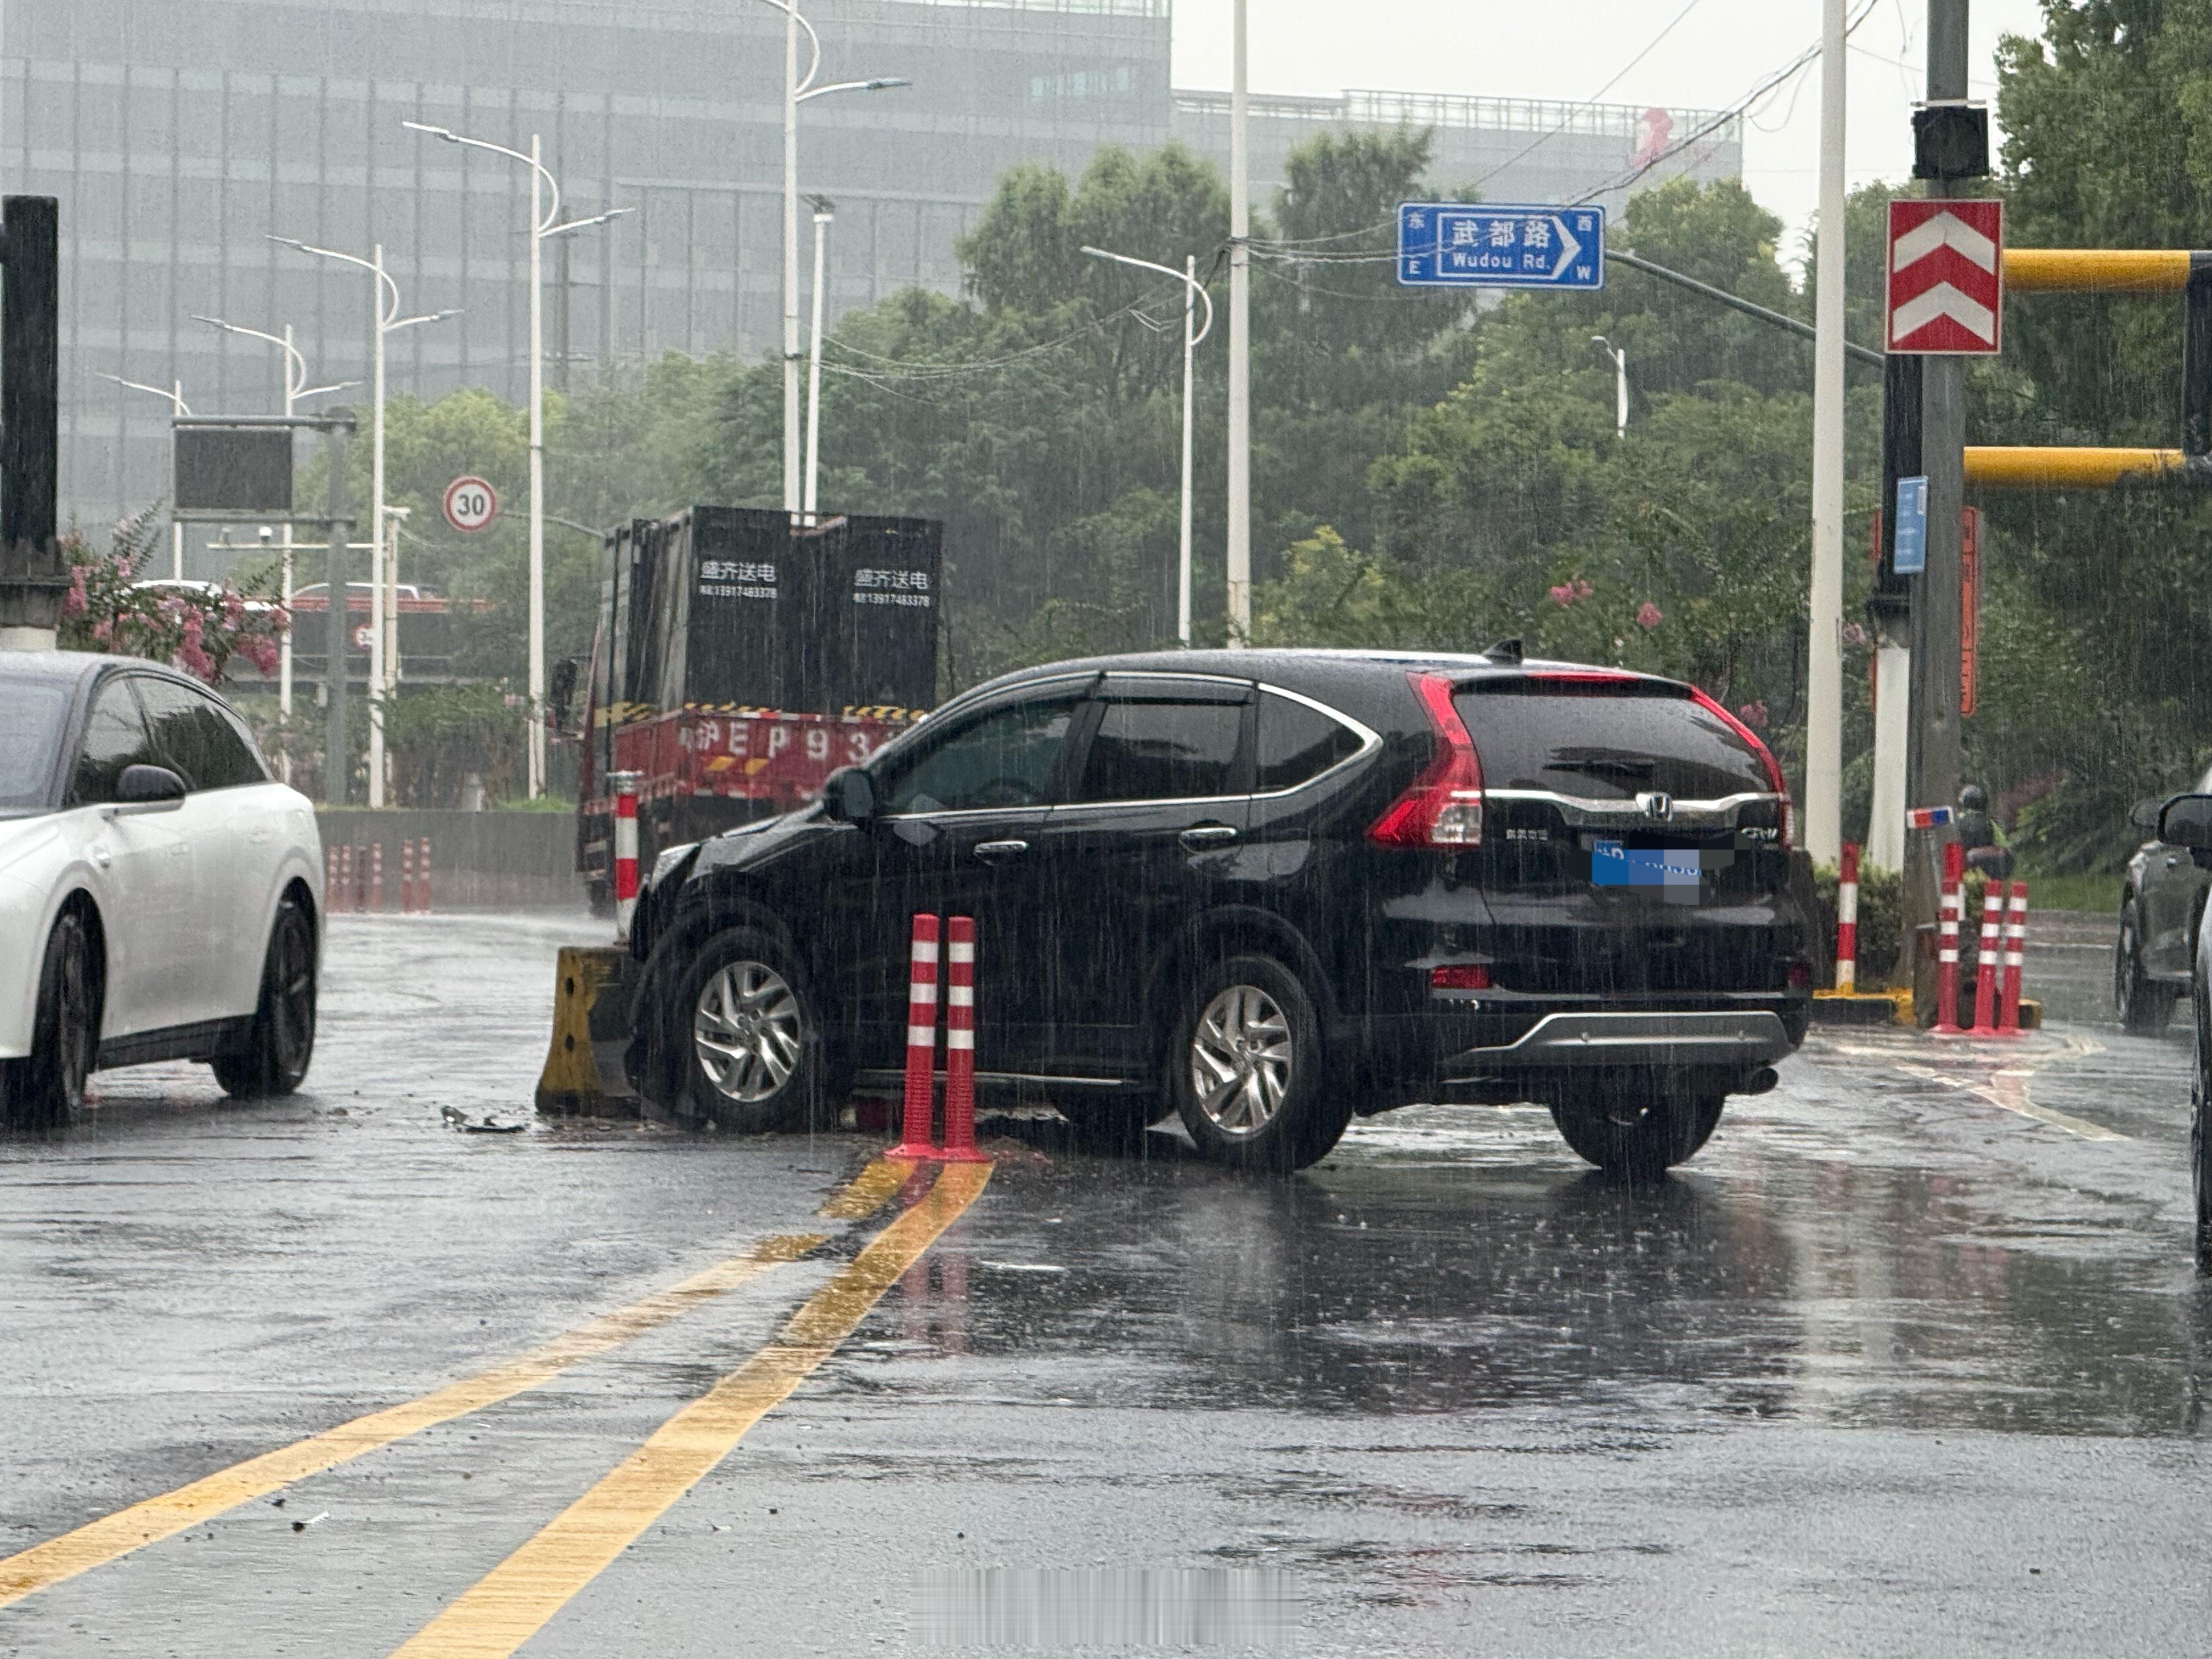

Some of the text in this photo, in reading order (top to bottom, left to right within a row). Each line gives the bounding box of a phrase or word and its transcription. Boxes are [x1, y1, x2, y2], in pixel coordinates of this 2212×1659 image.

[1408, 212, 1425, 229] 东
[1577, 215, 1592, 232] 西
[1453, 219, 1551, 248] 武都路
[1409, 260, 1421, 275] E
[1453, 252, 1551, 270] Wudou Rd.
[1577, 264, 1591, 279] W
[456, 494, 484, 516] 30
[680, 720, 897, 763] 沪EP93
